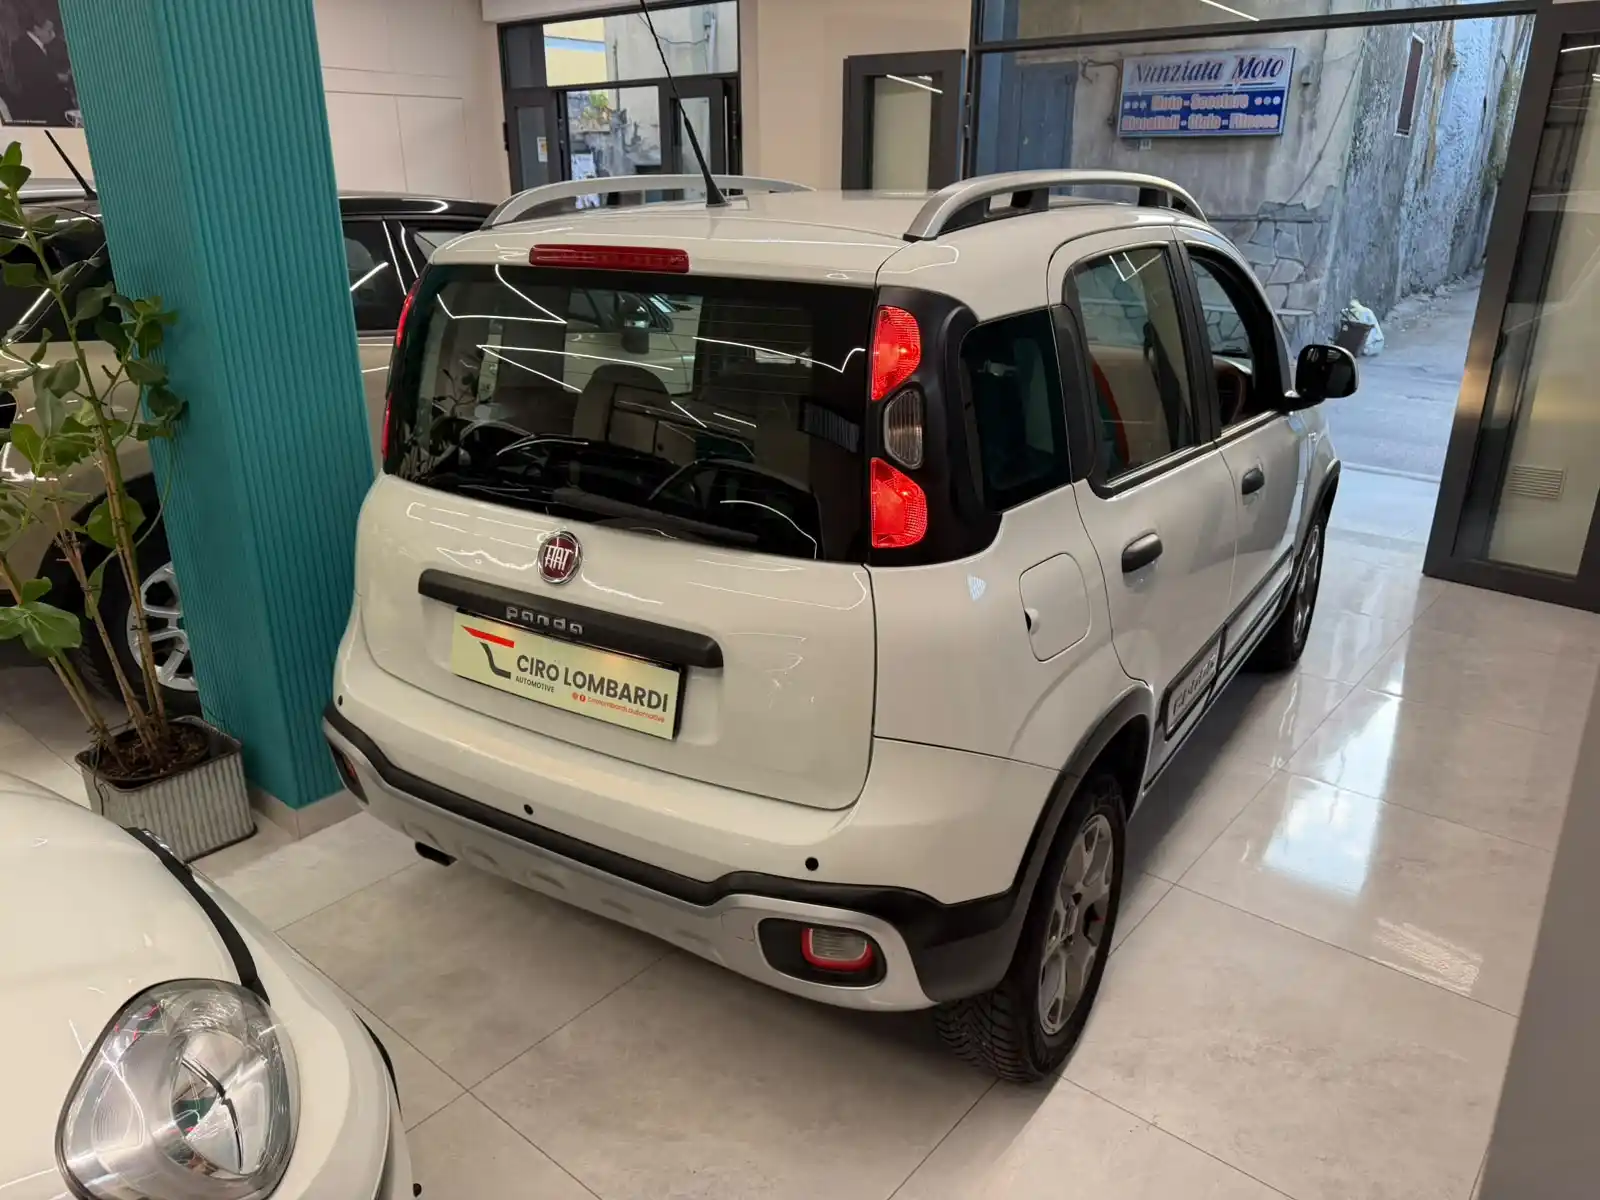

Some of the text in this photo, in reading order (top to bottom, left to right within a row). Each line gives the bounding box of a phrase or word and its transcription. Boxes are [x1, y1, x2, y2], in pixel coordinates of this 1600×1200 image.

[1231, 56, 1284, 80] Moto
[544, 544, 574, 571] FIAT
[506, 606, 583, 635] panda
[515, 675, 555, 694] AUTOMOTIVE
[516, 654, 669, 713] CIRO LOMBARDI
